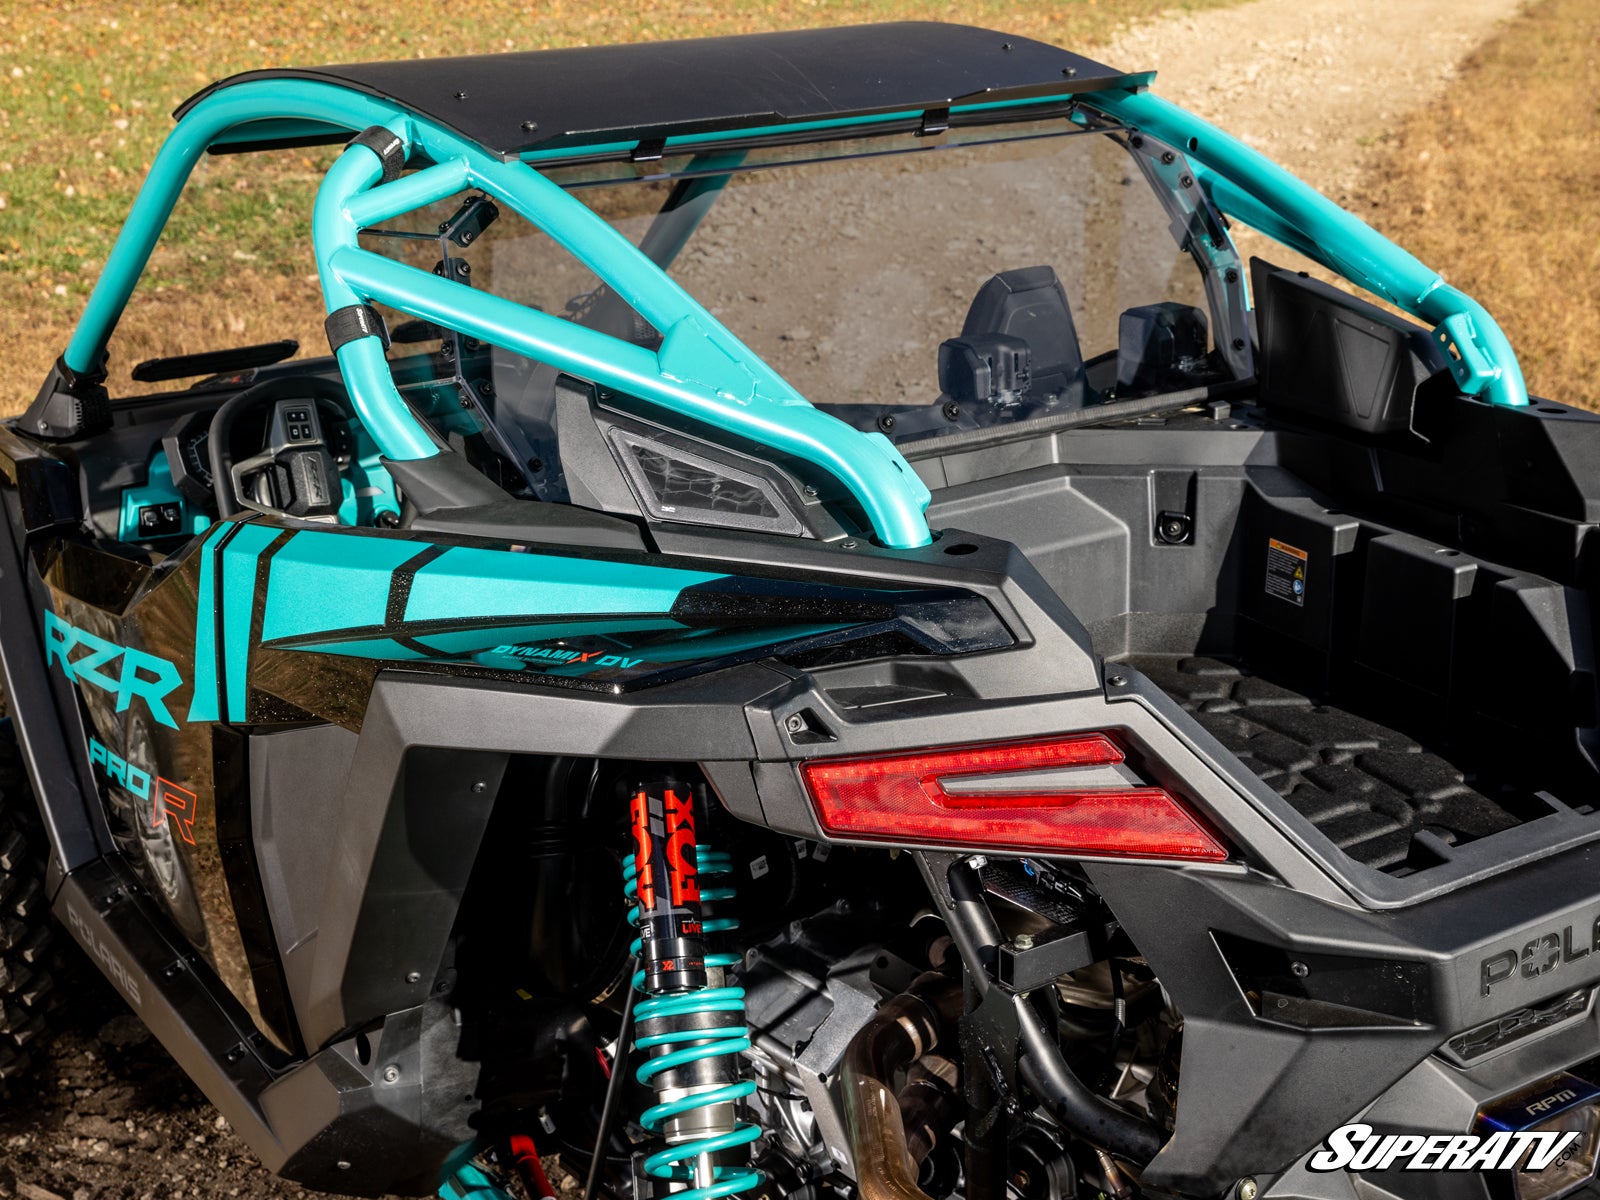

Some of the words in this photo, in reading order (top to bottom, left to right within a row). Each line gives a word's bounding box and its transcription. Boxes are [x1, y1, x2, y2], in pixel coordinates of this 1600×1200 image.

[44, 609, 183, 730] RZR
[491, 645, 607, 665] DYNAMIX
[594, 655, 645, 669] DV
[89, 737, 151, 801] PRO
[153, 776, 197, 846] R
[664, 789, 702, 907] FOX
[67, 901, 141, 1007] POLARIS
[661, 960, 675, 971] X2
[682, 922, 702, 934] LIVE
[1480, 914, 1600, 999] POL
[1525, 1089, 1578, 1116] RPM
